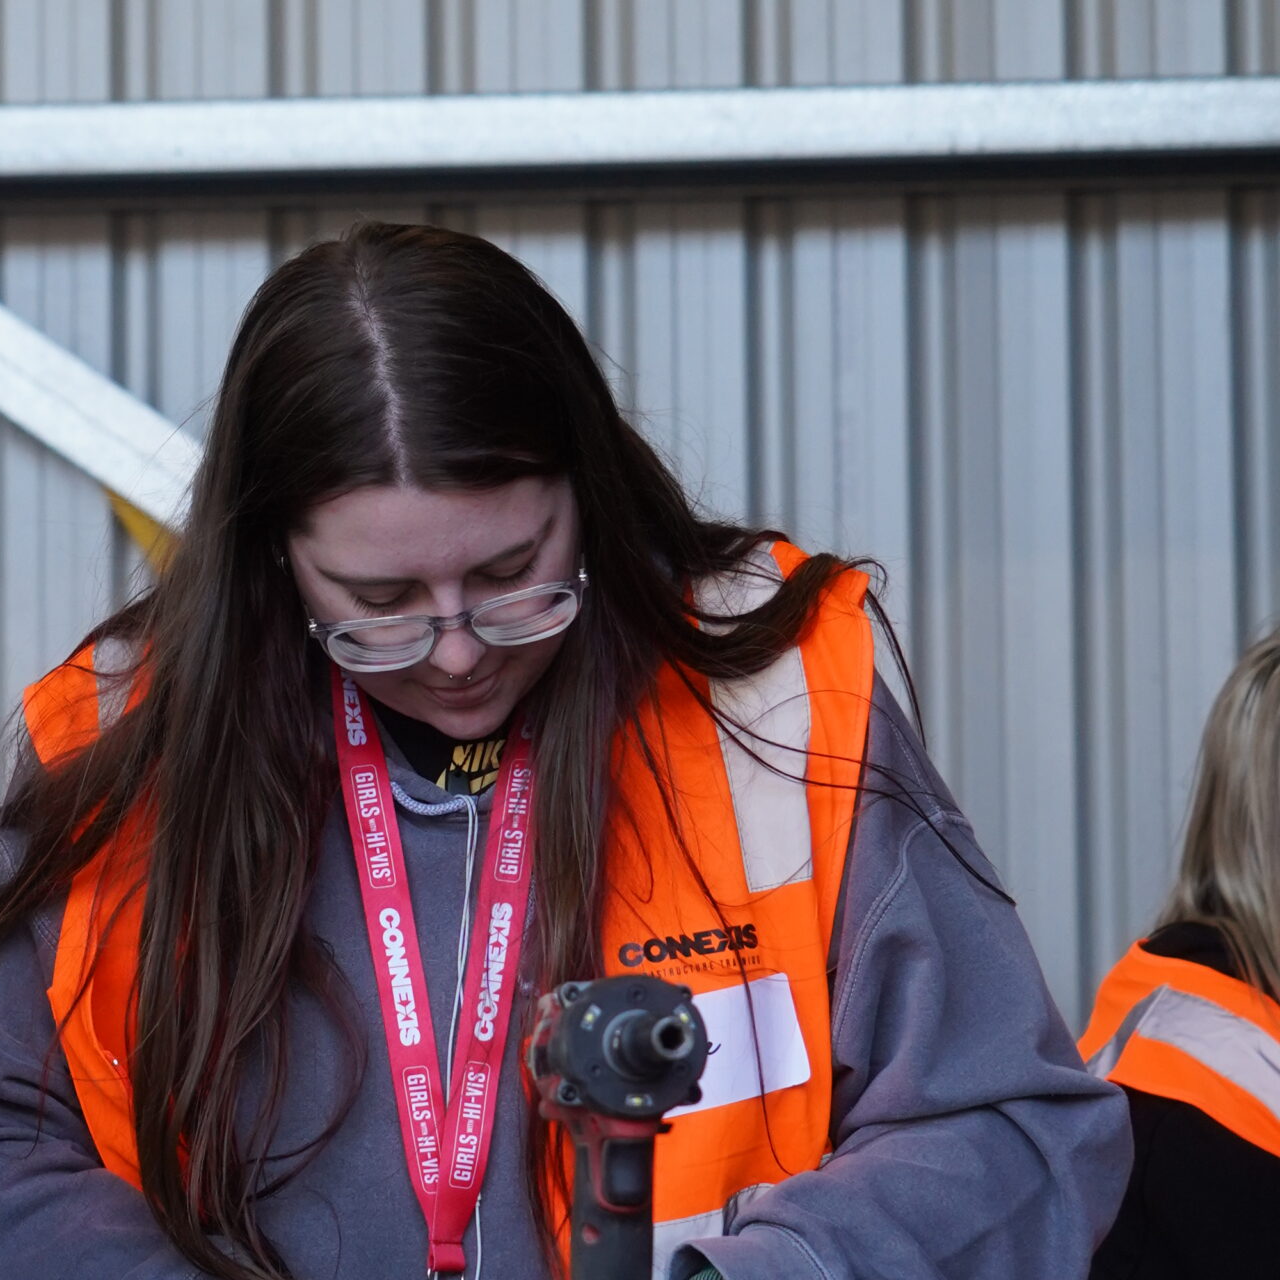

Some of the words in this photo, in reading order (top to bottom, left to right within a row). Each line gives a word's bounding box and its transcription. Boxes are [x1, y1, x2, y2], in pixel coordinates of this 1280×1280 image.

[449, 740, 506, 773] NIK
[354, 771, 381, 819] GIRLS
[366, 831, 392, 880] HI-VIS
[499, 829, 524, 876] GIRLS
[379, 907, 421, 1046] CONNEXIS
[474, 902, 513, 1042] CONNEXIS
[407, 1073, 432, 1122] GIRLS
[462, 1071, 487, 1121] HI-VIS
[453, 1133, 478, 1183] GIRLS
